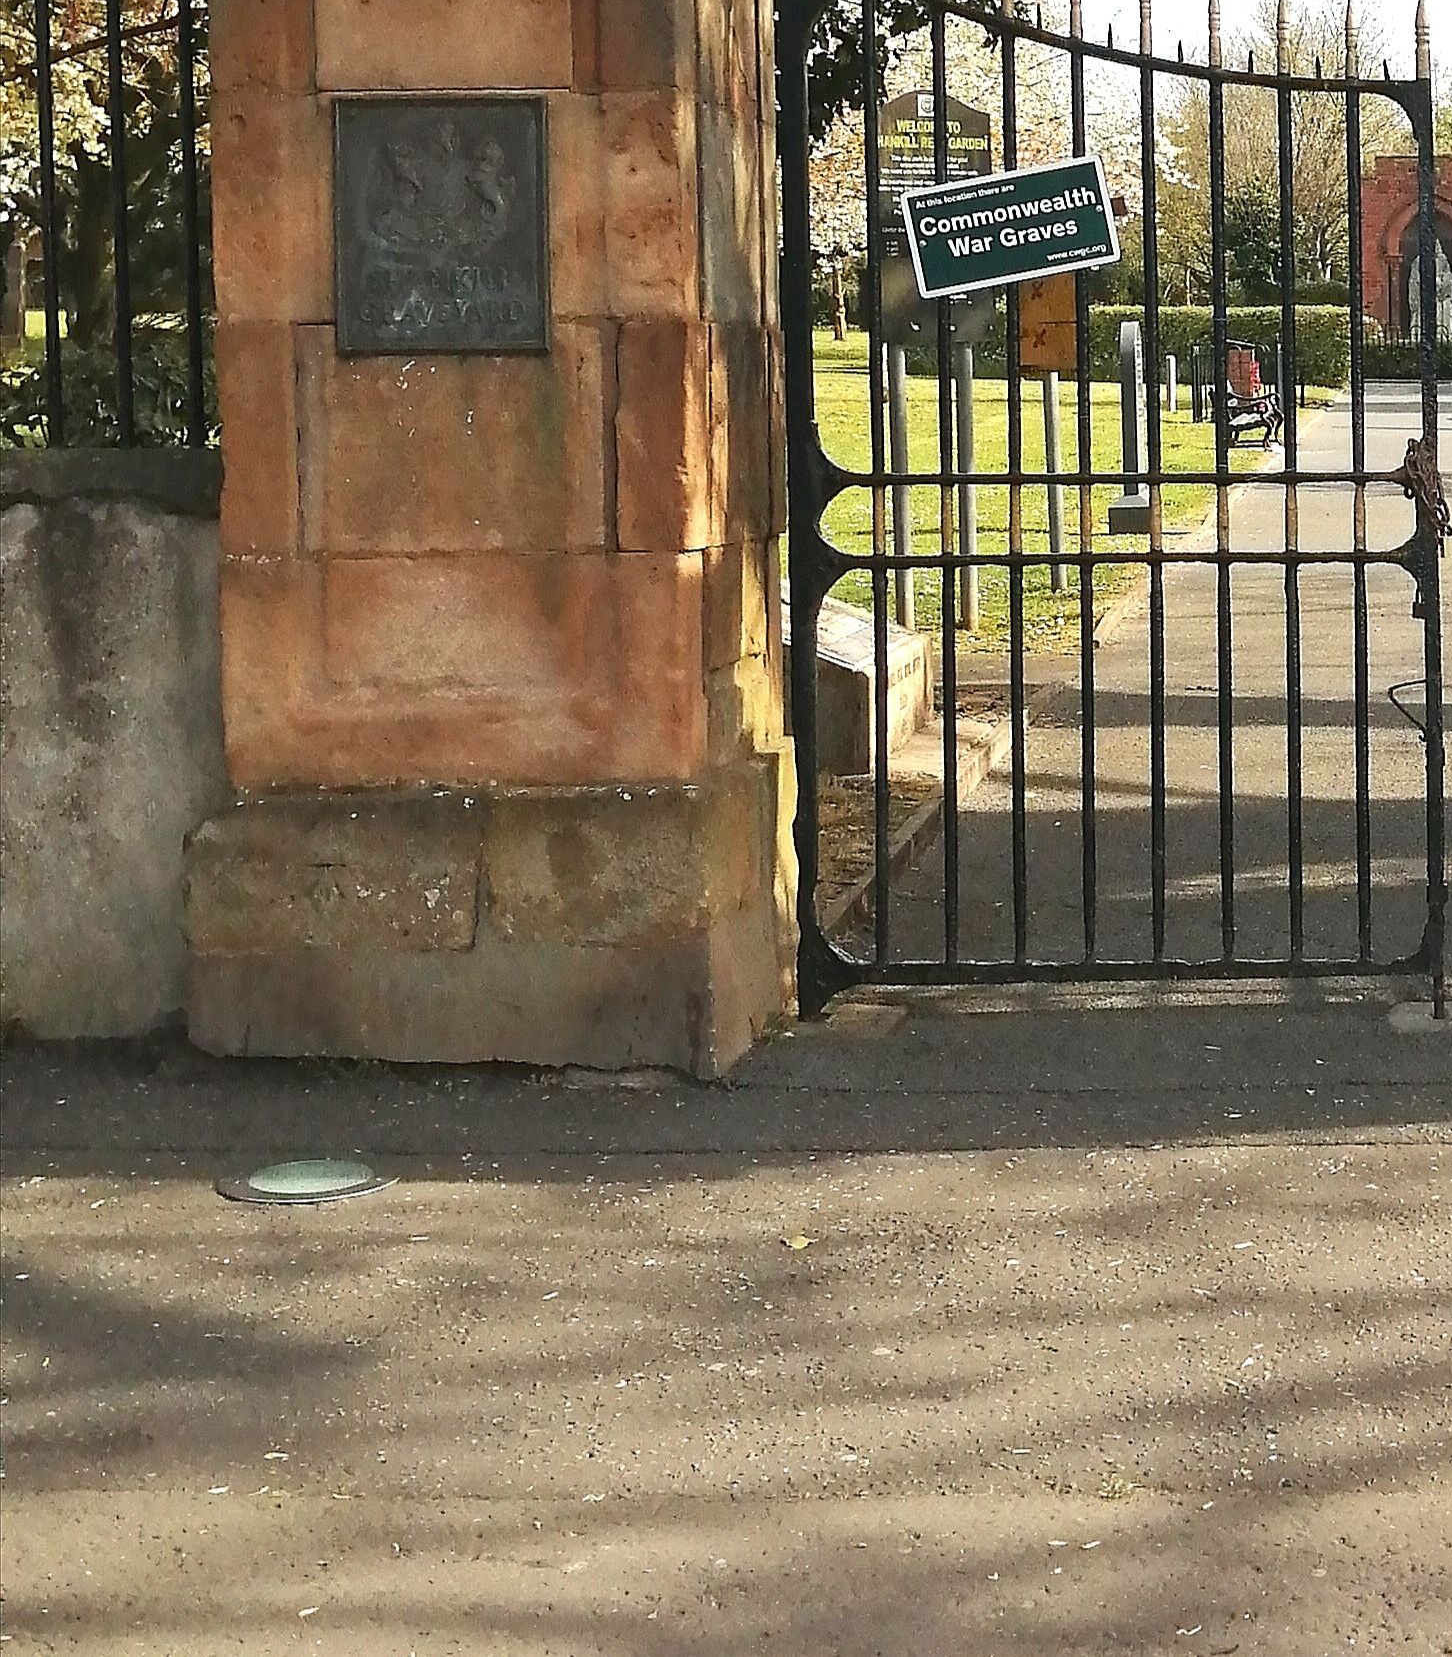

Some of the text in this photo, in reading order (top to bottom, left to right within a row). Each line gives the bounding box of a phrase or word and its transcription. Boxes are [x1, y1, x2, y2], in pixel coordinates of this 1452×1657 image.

[896, 119, 962, 134] WELCO TO
[877, 133, 920, 149] HANKILL
[948, 135, 988, 151] GARDEN
[915, 184, 1015, 209] At this location there are
[919, 187, 1097, 237] Commonwealth
[947, 219, 1078, 258] War Graves
[1046, 243, 1107, 262] www.cwgc.org
